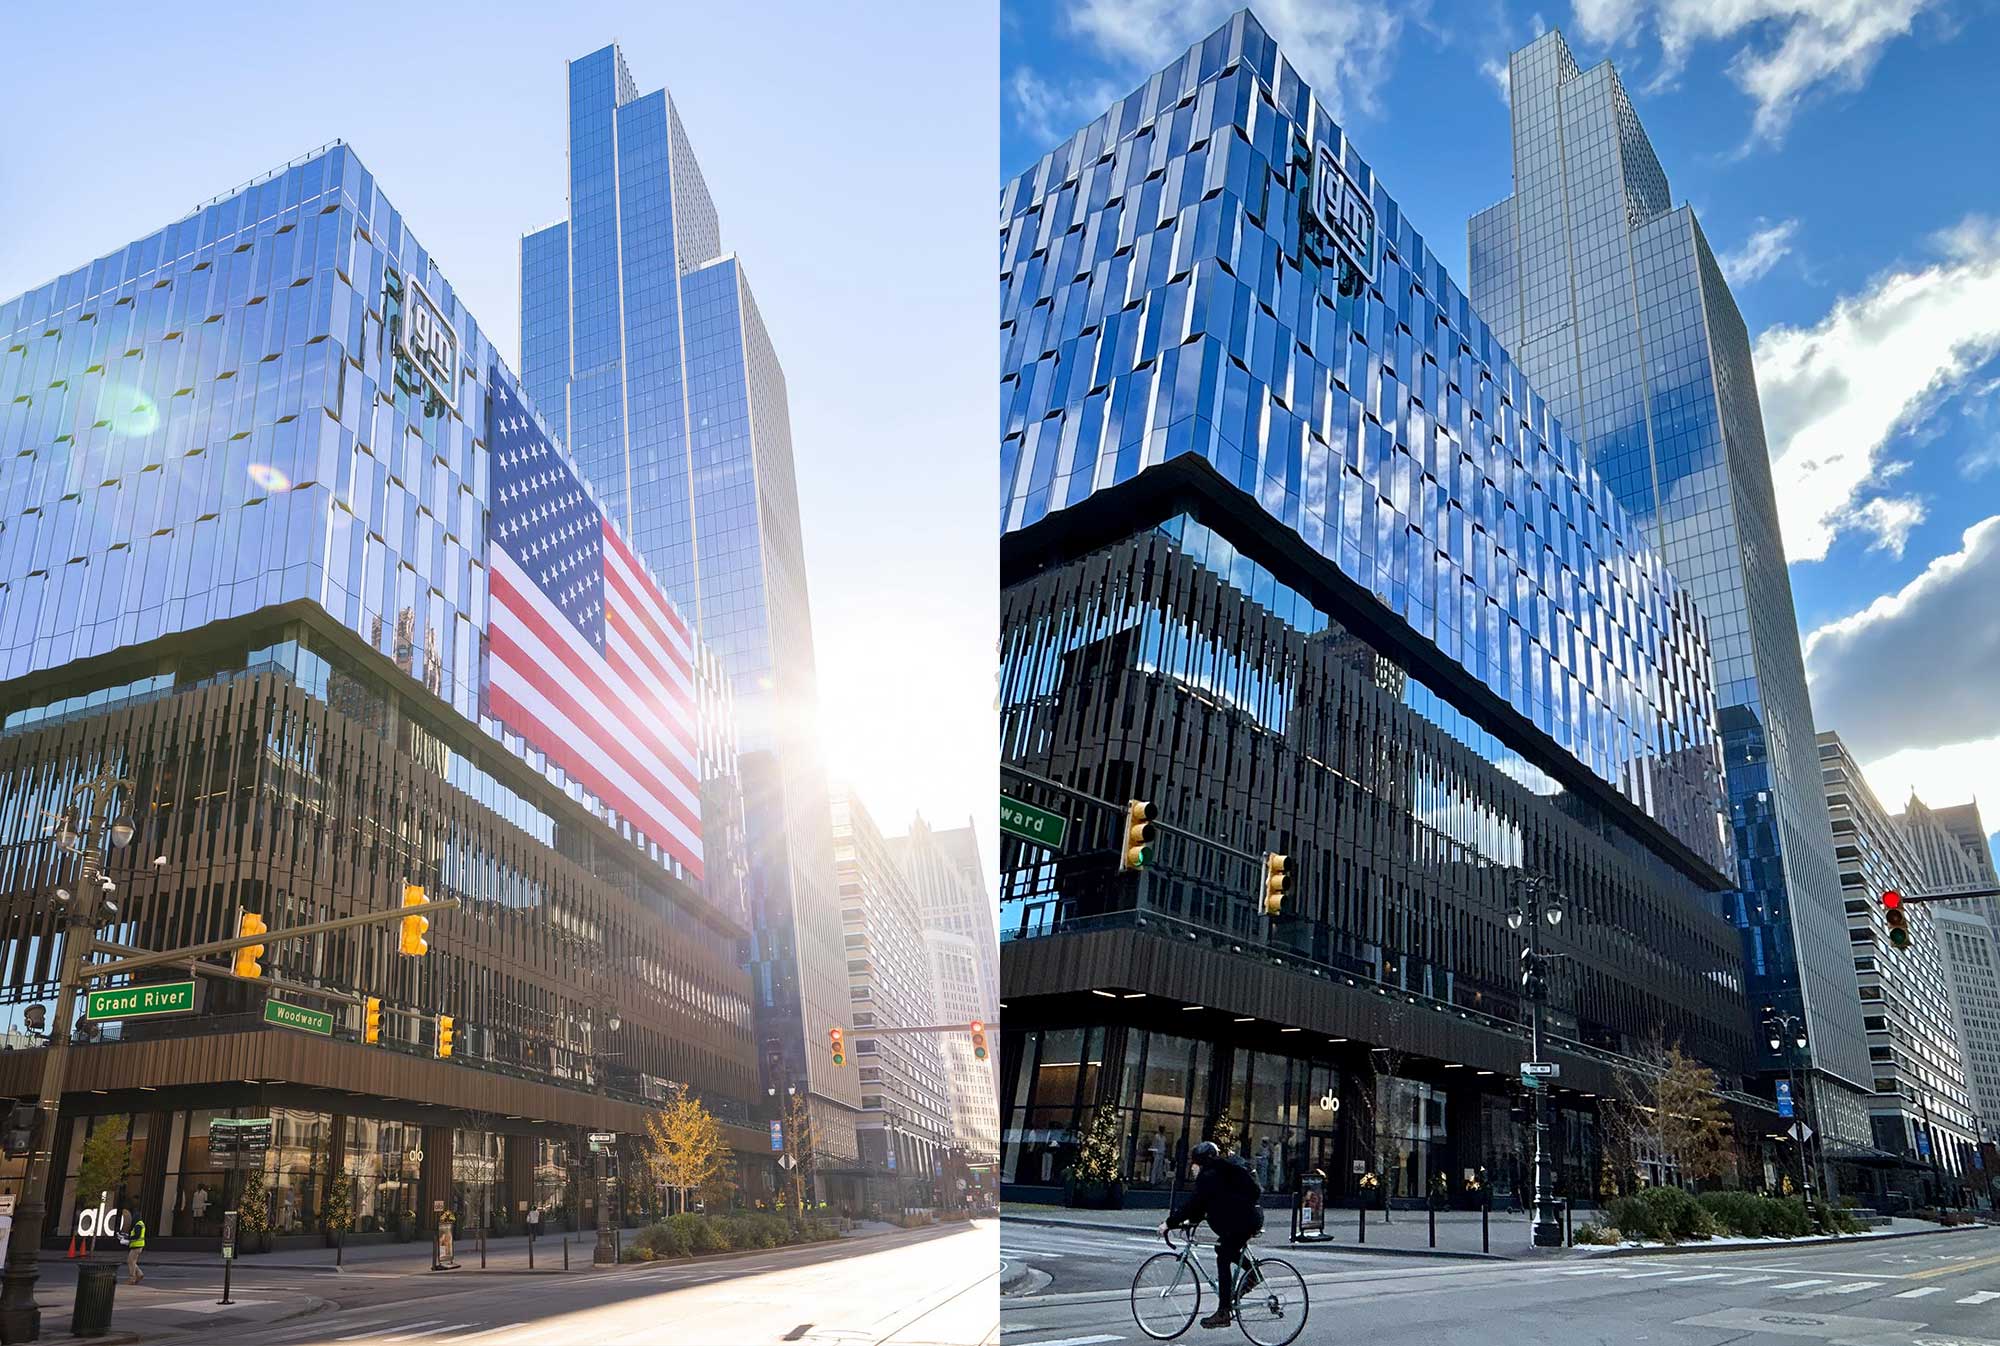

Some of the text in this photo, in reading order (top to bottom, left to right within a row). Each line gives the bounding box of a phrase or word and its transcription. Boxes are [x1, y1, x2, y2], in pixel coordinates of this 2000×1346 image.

[1000, 806, 1044, 832] ward
[96, 990, 185, 1011] Grand River
[277, 1006, 323, 1028] Woodward
[1320, 1088, 1340, 1112] alo
[409, 1144, 424, 1162] alo
[78, 1190, 123, 1236] alo
